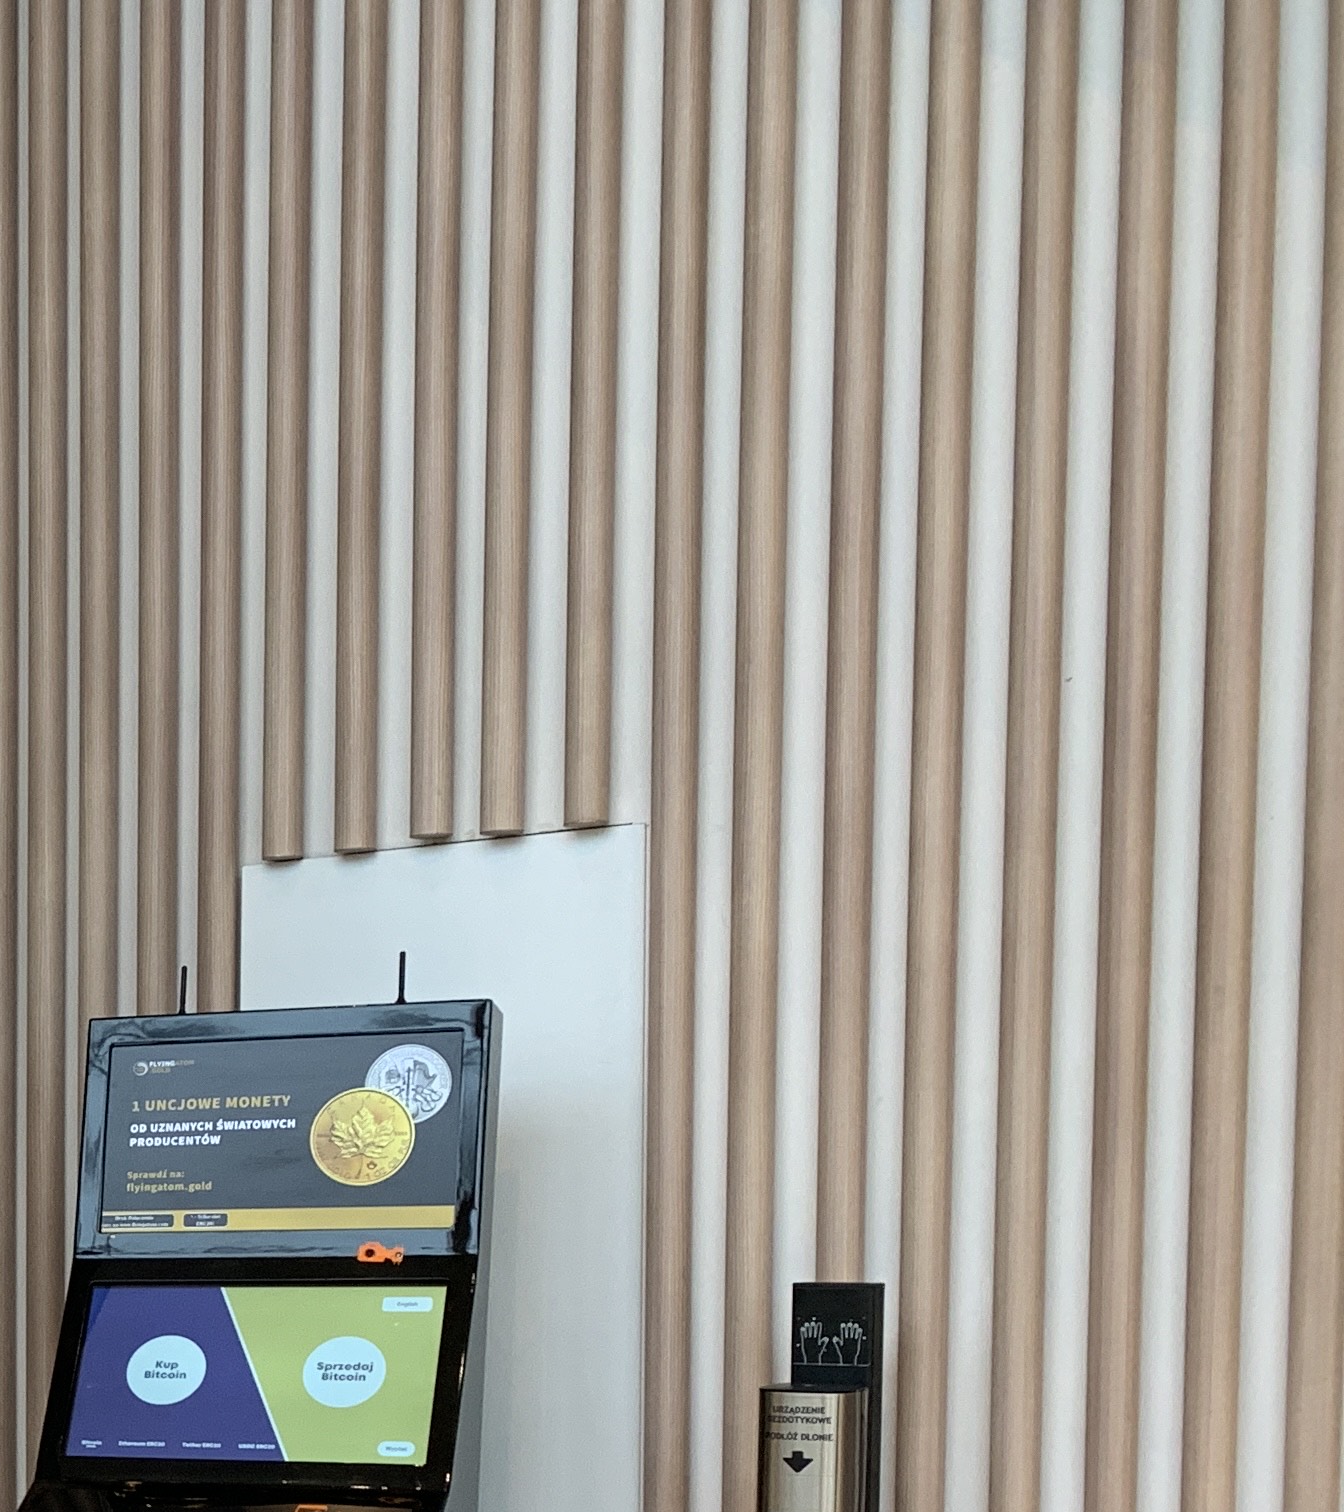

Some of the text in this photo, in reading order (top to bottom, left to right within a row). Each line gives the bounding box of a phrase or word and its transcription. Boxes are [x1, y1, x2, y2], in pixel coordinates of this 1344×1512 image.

[131, 1095, 291, 1112] 1 UNCJOWE MONETY
[130, 1118, 296, 1133] OD UZNANYCH ŚWIATOWYCH
[129, 1133, 221, 1147] PRODUCENTÓW
[169, 1170, 185, 1178] na:
[126, 1181, 212, 1194] flyingatom.gold
[155, 1360, 179, 1370] Kup
[317, 1361, 374, 1373] Sprzedaj
[144, 1370, 187, 1380] Bitcoin
[321, 1372, 367, 1382] Bitcoin
